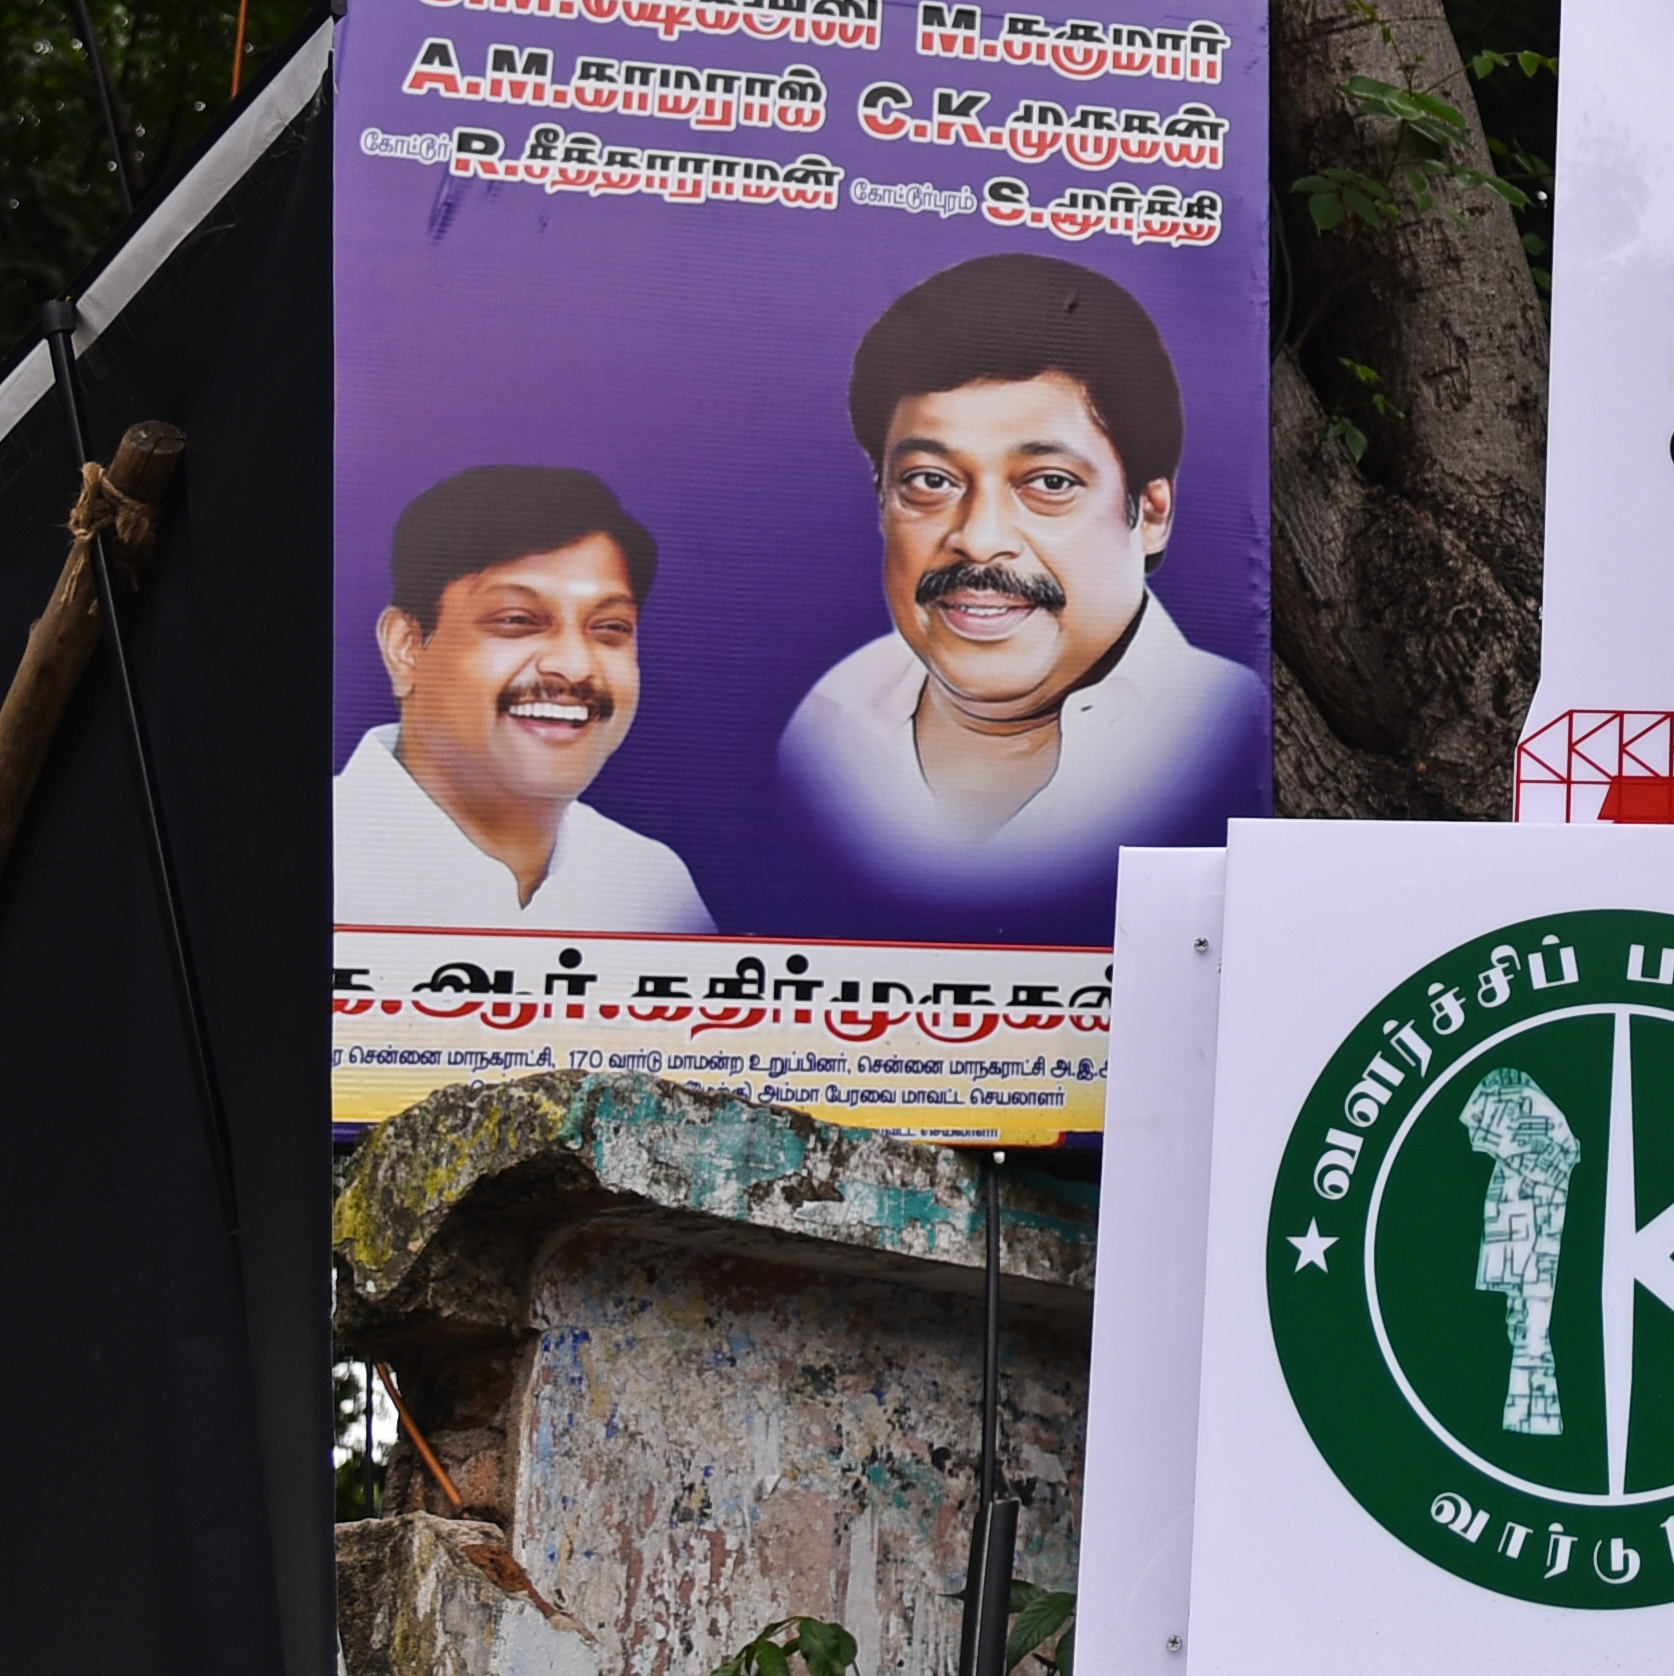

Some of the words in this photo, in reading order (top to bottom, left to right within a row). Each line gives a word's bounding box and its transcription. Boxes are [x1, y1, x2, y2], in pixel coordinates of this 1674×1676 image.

[349, 1045, 442, 1066] சென்னை
[569, 1050, 603, 1069] 170
[609, 1049, 662, 1072] வார்டு
[668, 1051, 744, 1076] மாமன்ற
[857, 1054, 943, 1075] சென்னை
[950, 1055, 1045, 1081] மாநகராட்சி
[1313, 934, 1579, 1200] வளர்ச்சிப்
[757, 1081, 820, 1103] அம்மா
[825, 1083, 896, 1106] பேரவை
[902, 1087, 964, 1105] மாவட்ட
[970, 1087, 1065, 1106] செயலாளர்
